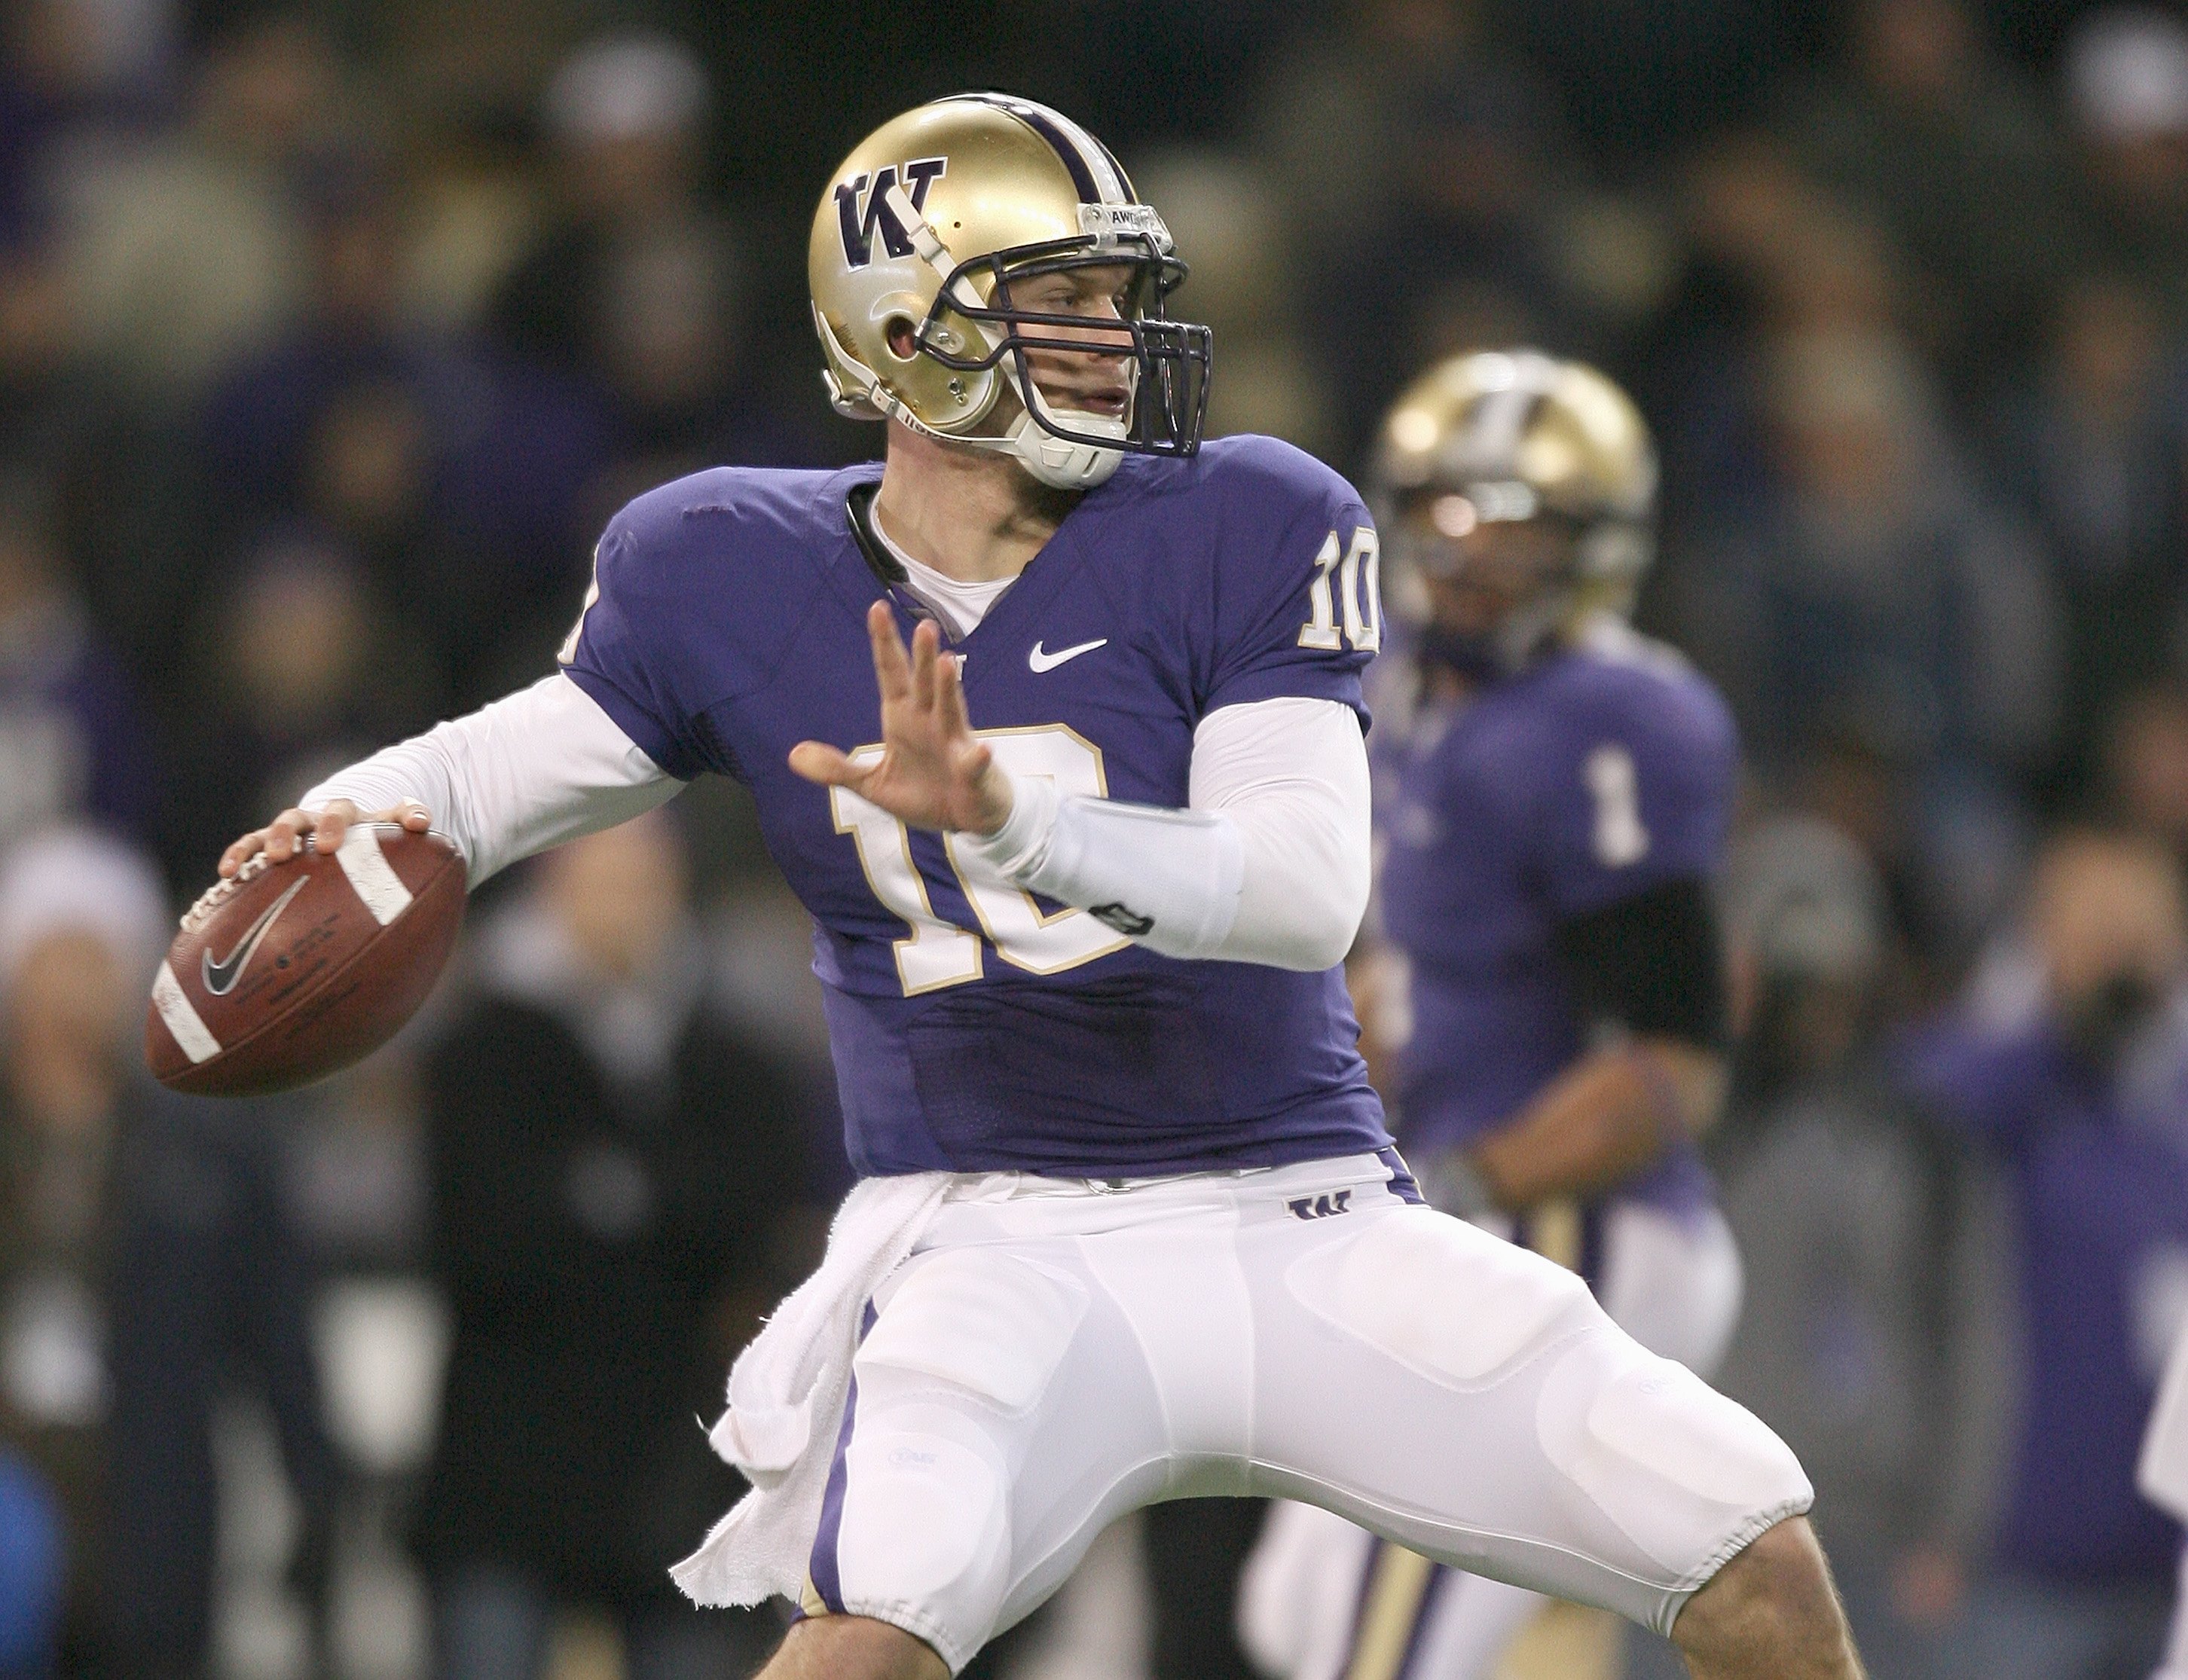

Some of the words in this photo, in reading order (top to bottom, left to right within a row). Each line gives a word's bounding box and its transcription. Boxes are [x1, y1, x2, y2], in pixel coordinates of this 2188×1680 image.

[833, 157, 948, 273] W
[1297, 526, 1380, 657] 10
[830, 723, 1134, 997] 10
[1587, 744, 1648, 865] 1
